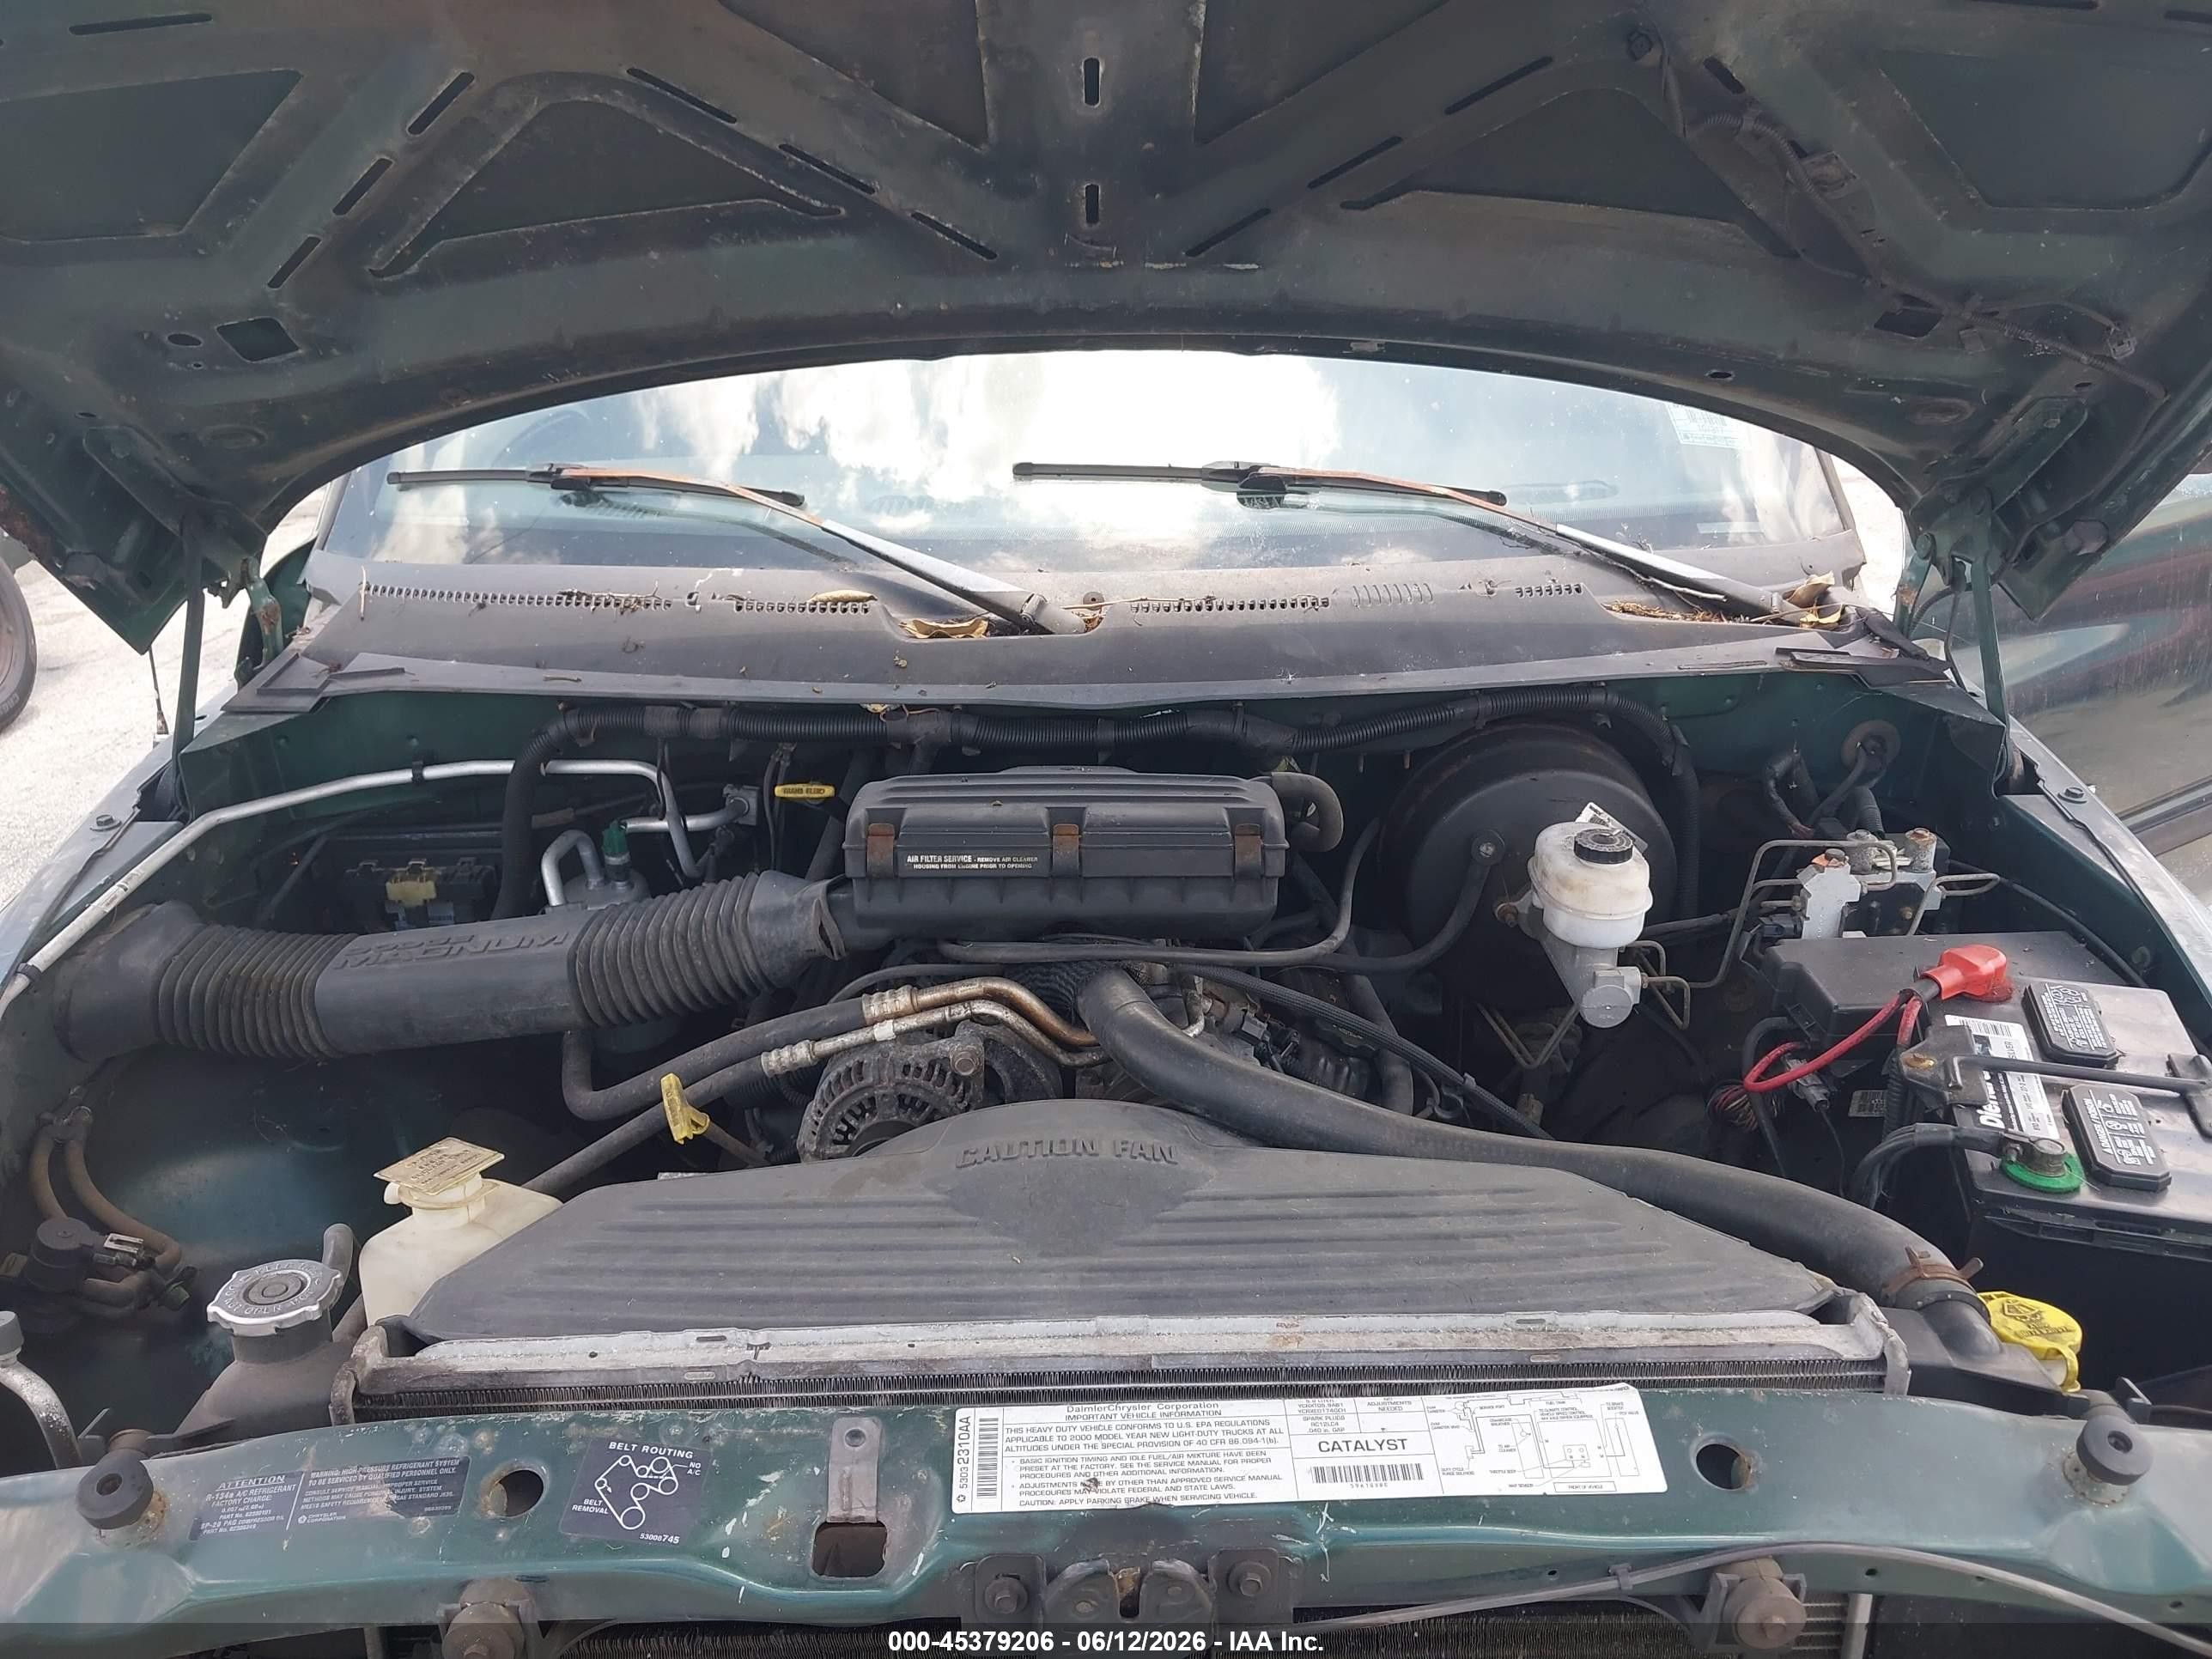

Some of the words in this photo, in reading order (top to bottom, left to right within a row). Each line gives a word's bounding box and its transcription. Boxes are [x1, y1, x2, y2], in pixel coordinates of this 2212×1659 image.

[955, 1138, 1099, 1169] CAUTION
[1114, 1139, 1179, 1165] FAN
[1067, 1404, 1150, 1413] DaimlerChrysler
[1157, 1402, 1219, 1410] Corporation
[608, 1442, 638, 1452] BELT
[641, 1445, 694, 1459] ROUTING
[1318, 1439, 1408, 1452] CATALYST
[392, 1460, 434, 1471] REFRIGERANT
[328, 1476, 357, 1485] SERVICED
[401, 1468, 438, 1478] PERSONNEL
[219, 1475, 286, 1490] ATTENTION
[249, 1484, 297, 1495] REFRIGERANT
[212, 1498, 242, 1507] FACTORY
[583, 1498, 602, 1507] BELT
[571, 1504, 609, 1515] REMOVAL
[639, 1532, 681, 1544] 53008745
